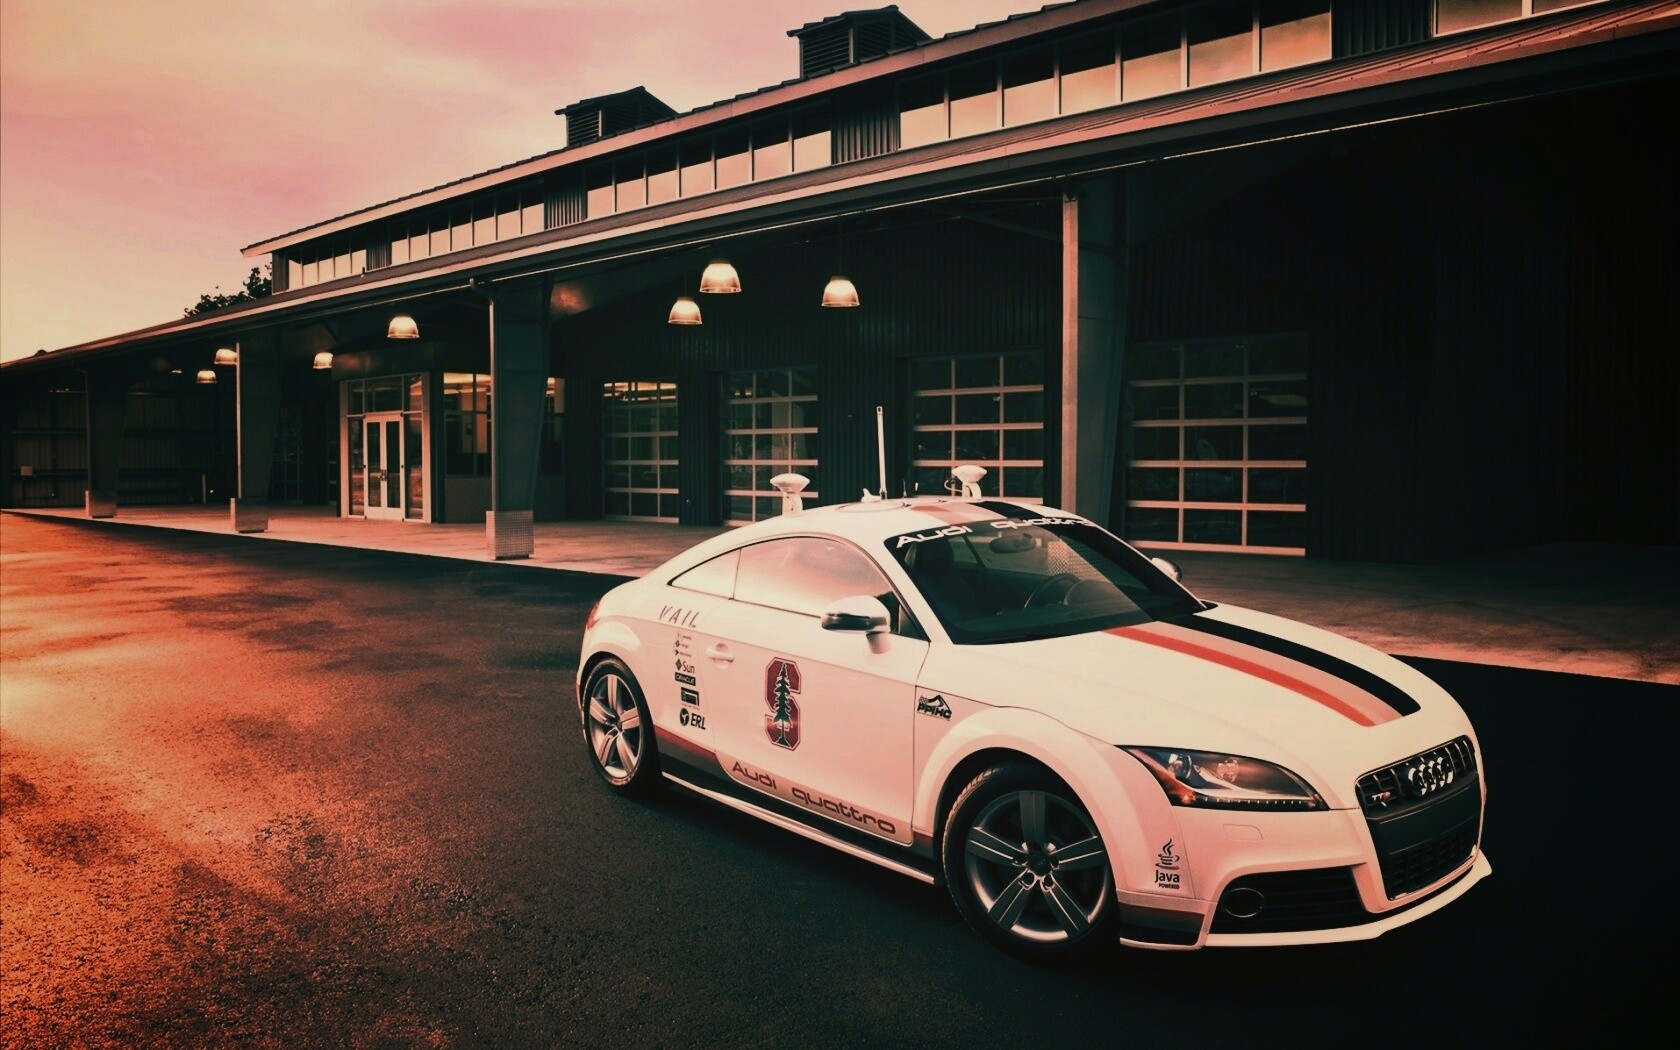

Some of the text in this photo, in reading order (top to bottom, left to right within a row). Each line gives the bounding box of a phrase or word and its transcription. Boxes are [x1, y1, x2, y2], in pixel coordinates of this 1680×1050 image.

[897, 525, 973, 549] Audi
[659, 605, 699, 628] VAIL
[682, 660, 695, 674] Sun
[690, 713, 706, 730] ERL
[732, 761, 896, 835] Audi quattro
[1154, 869, 1180, 884] Java
